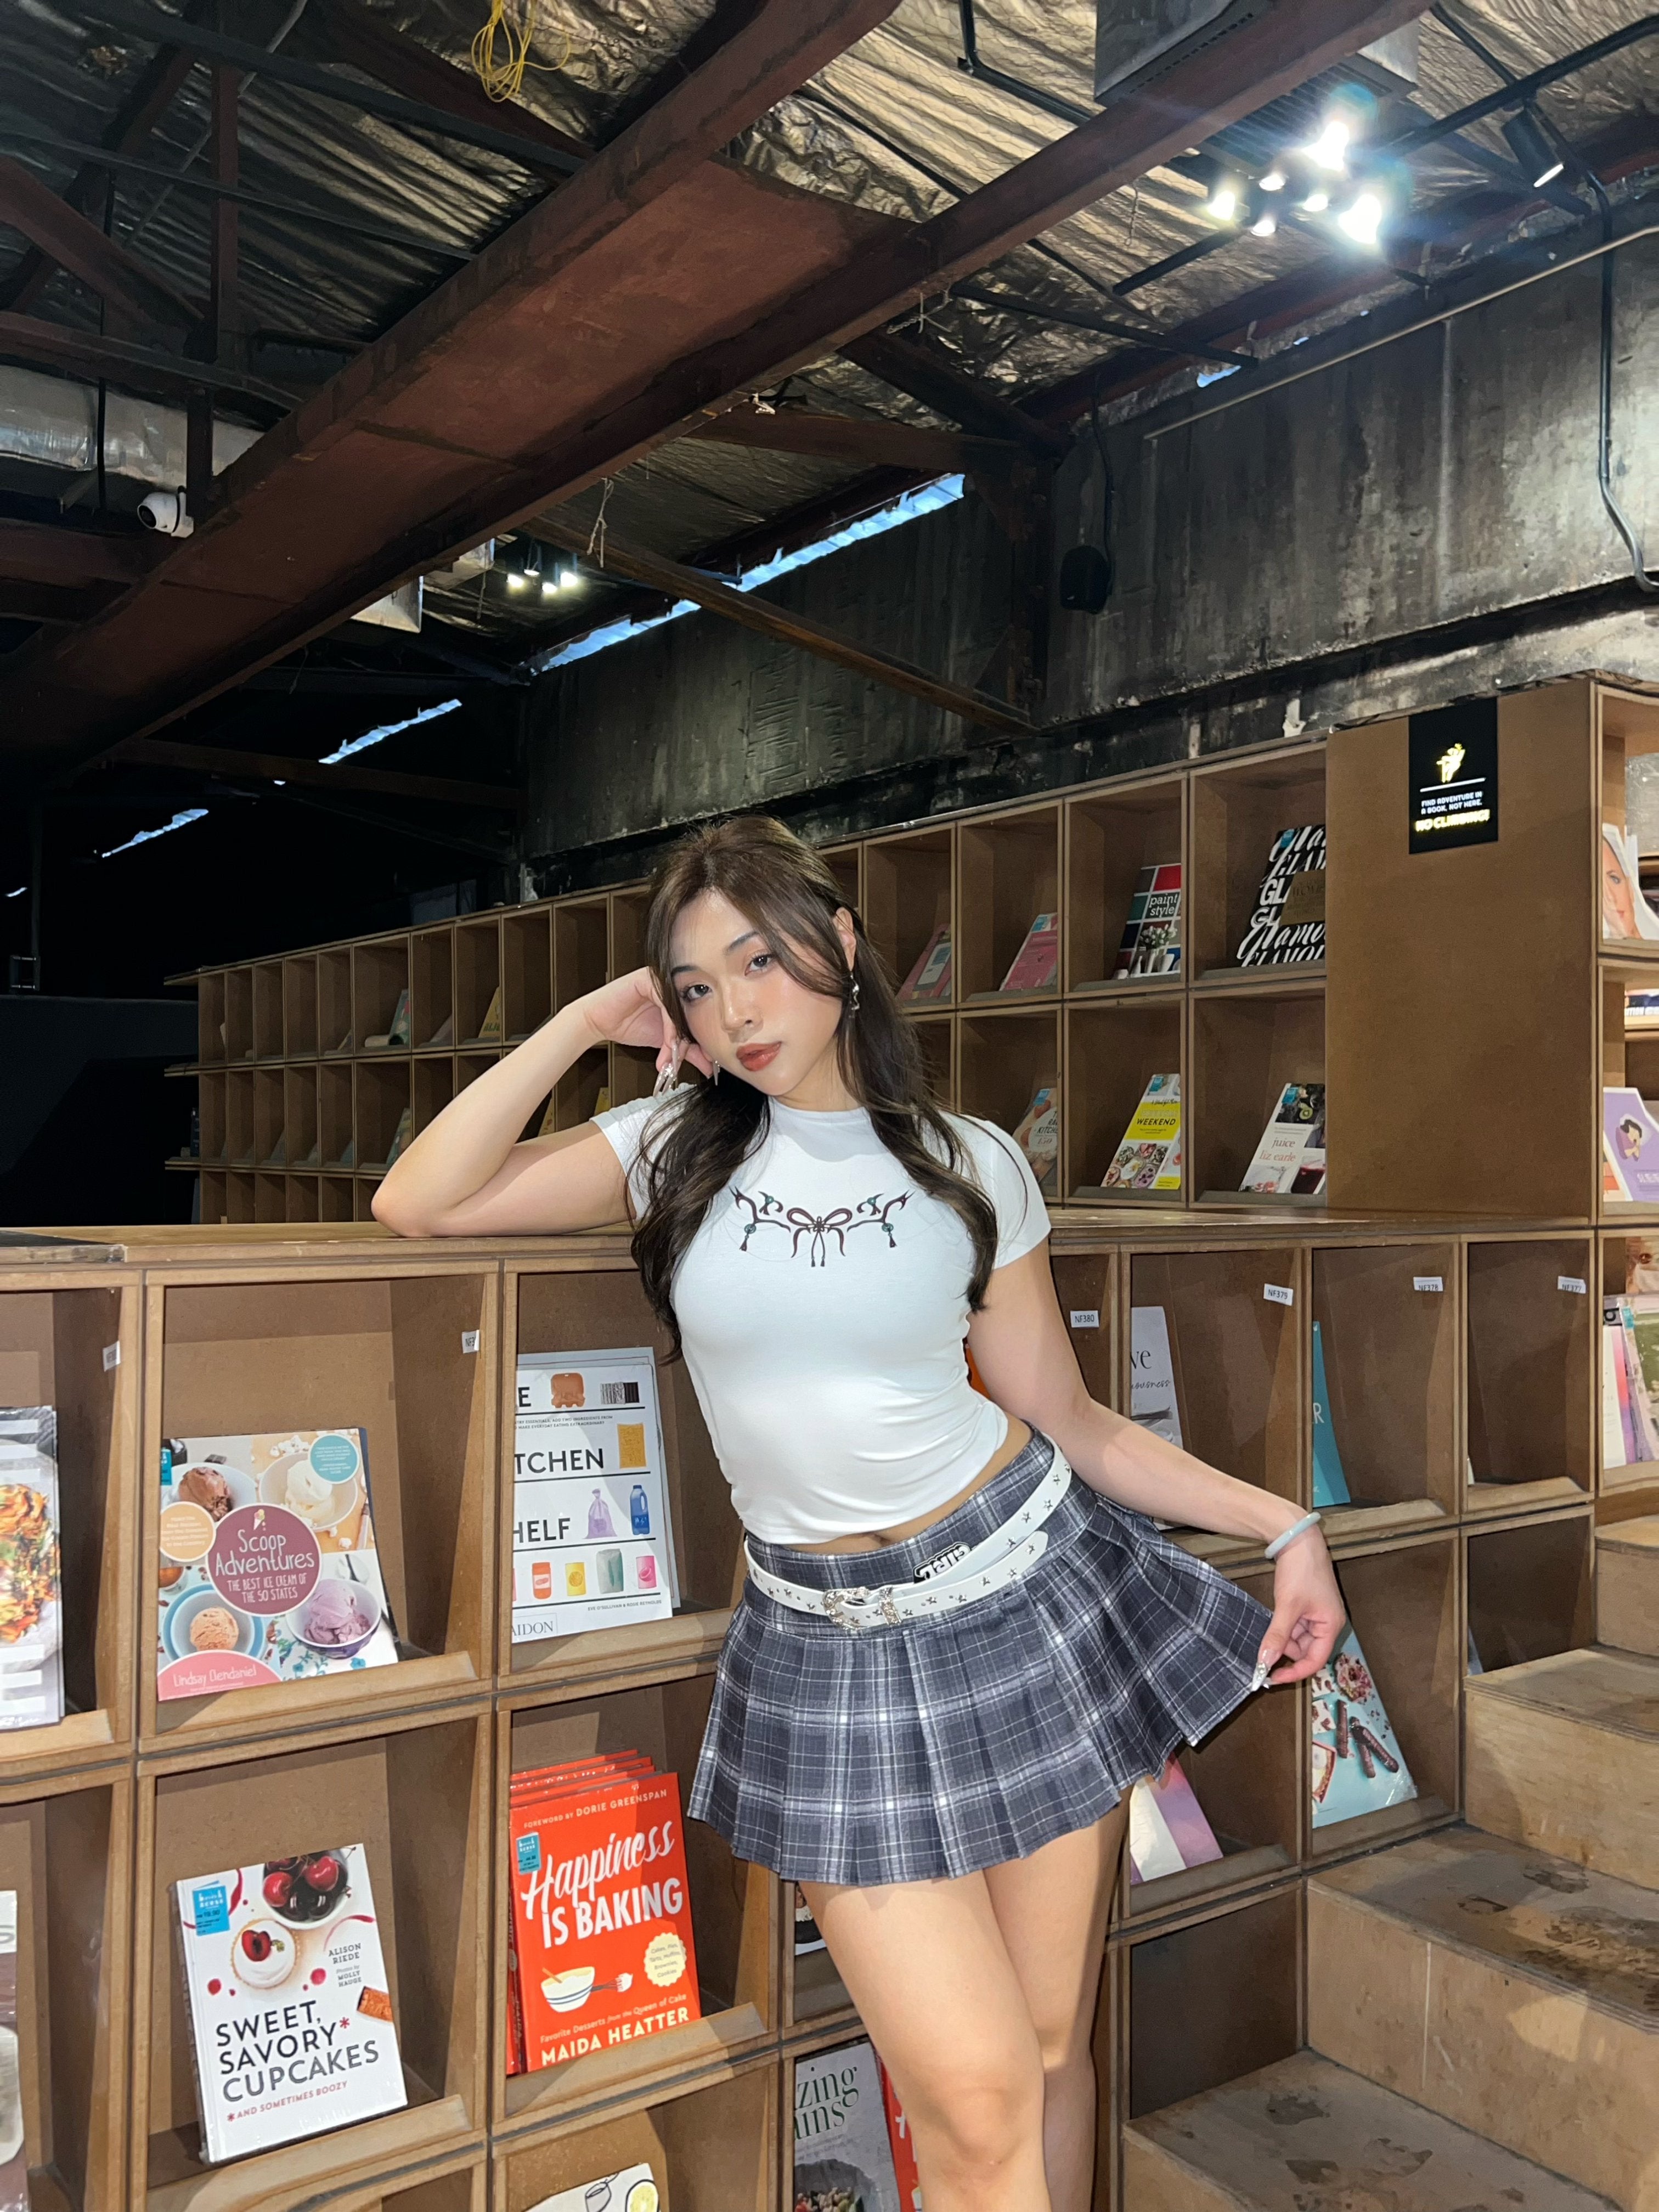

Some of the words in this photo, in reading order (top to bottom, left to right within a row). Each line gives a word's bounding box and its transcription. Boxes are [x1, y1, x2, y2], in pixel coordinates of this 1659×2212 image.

[1421, 798, 1436, 807] FIND
[1437, 791, 1474, 804] ADVENTURE
[1449, 802, 1463, 810] NOT
[1149, 893, 1178, 908] paint
[1150, 902, 1175, 918] style
[1271, 1137, 1296, 1149] juice
[1260, 1150, 1271, 1161] liz
[1273, 1152, 1296, 1162] earle
[1268, 1288, 1288, 1300] NF379
[1075, 1314, 1095, 1323] NF380
[237, 1529, 287, 1556] Scoop
[215, 1549, 315, 1577] Adventures
[227, 1579, 241, 1592] THE
[242, 1577, 261, 1591] BEST
[263, 1575, 273, 1588] ICE
[275, 1573, 298, 1588] CREAM
[298, 1572, 307, 1585] OF
[241, 1591, 256, 1604] THE
[257, 1589, 269, 1602] 50
[271, 1586, 298, 1601] STATES
[173, 1671, 207, 1688] Lindsay
[523, 1814, 563, 1829] FOREWORD
[576, 1802, 607, 1817] DORIE
[610, 1789, 667, 1810] GREENSPAN
[521, 1820, 675, 1920] Happiness
[541, 1903, 569, 1949] IS
[575, 1877, 684, 1940] BAKING
[329, 1943, 362, 1957] ALISON
[332, 1952, 360, 1965] RIEDE
[338, 1970, 361, 1981] MOLLY
[338, 1977, 362, 1988] HAUGE
[216, 1999, 323, 2048] SWEET,
[540, 2029, 571, 2044] Favorite
[573, 2018, 606, 2034] Desserts
[607, 2014, 622, 2024] from
[633, 2002, 658, 2016] Queen
[659, 1997, 667, 2008] of
[668, 1993, 687, 2005] Cake
[541, 2033, 602, 2067] MAIDA
[607, 2006, 690, 2045] HEATTER
[222, 2039, 380, 2103] CUPCAKES
[796, 2067, 860, 2108] zing
[259, 2090, 314, 2113] SOMETIMES
[316, 2080, 348, 2097] BOOZY
